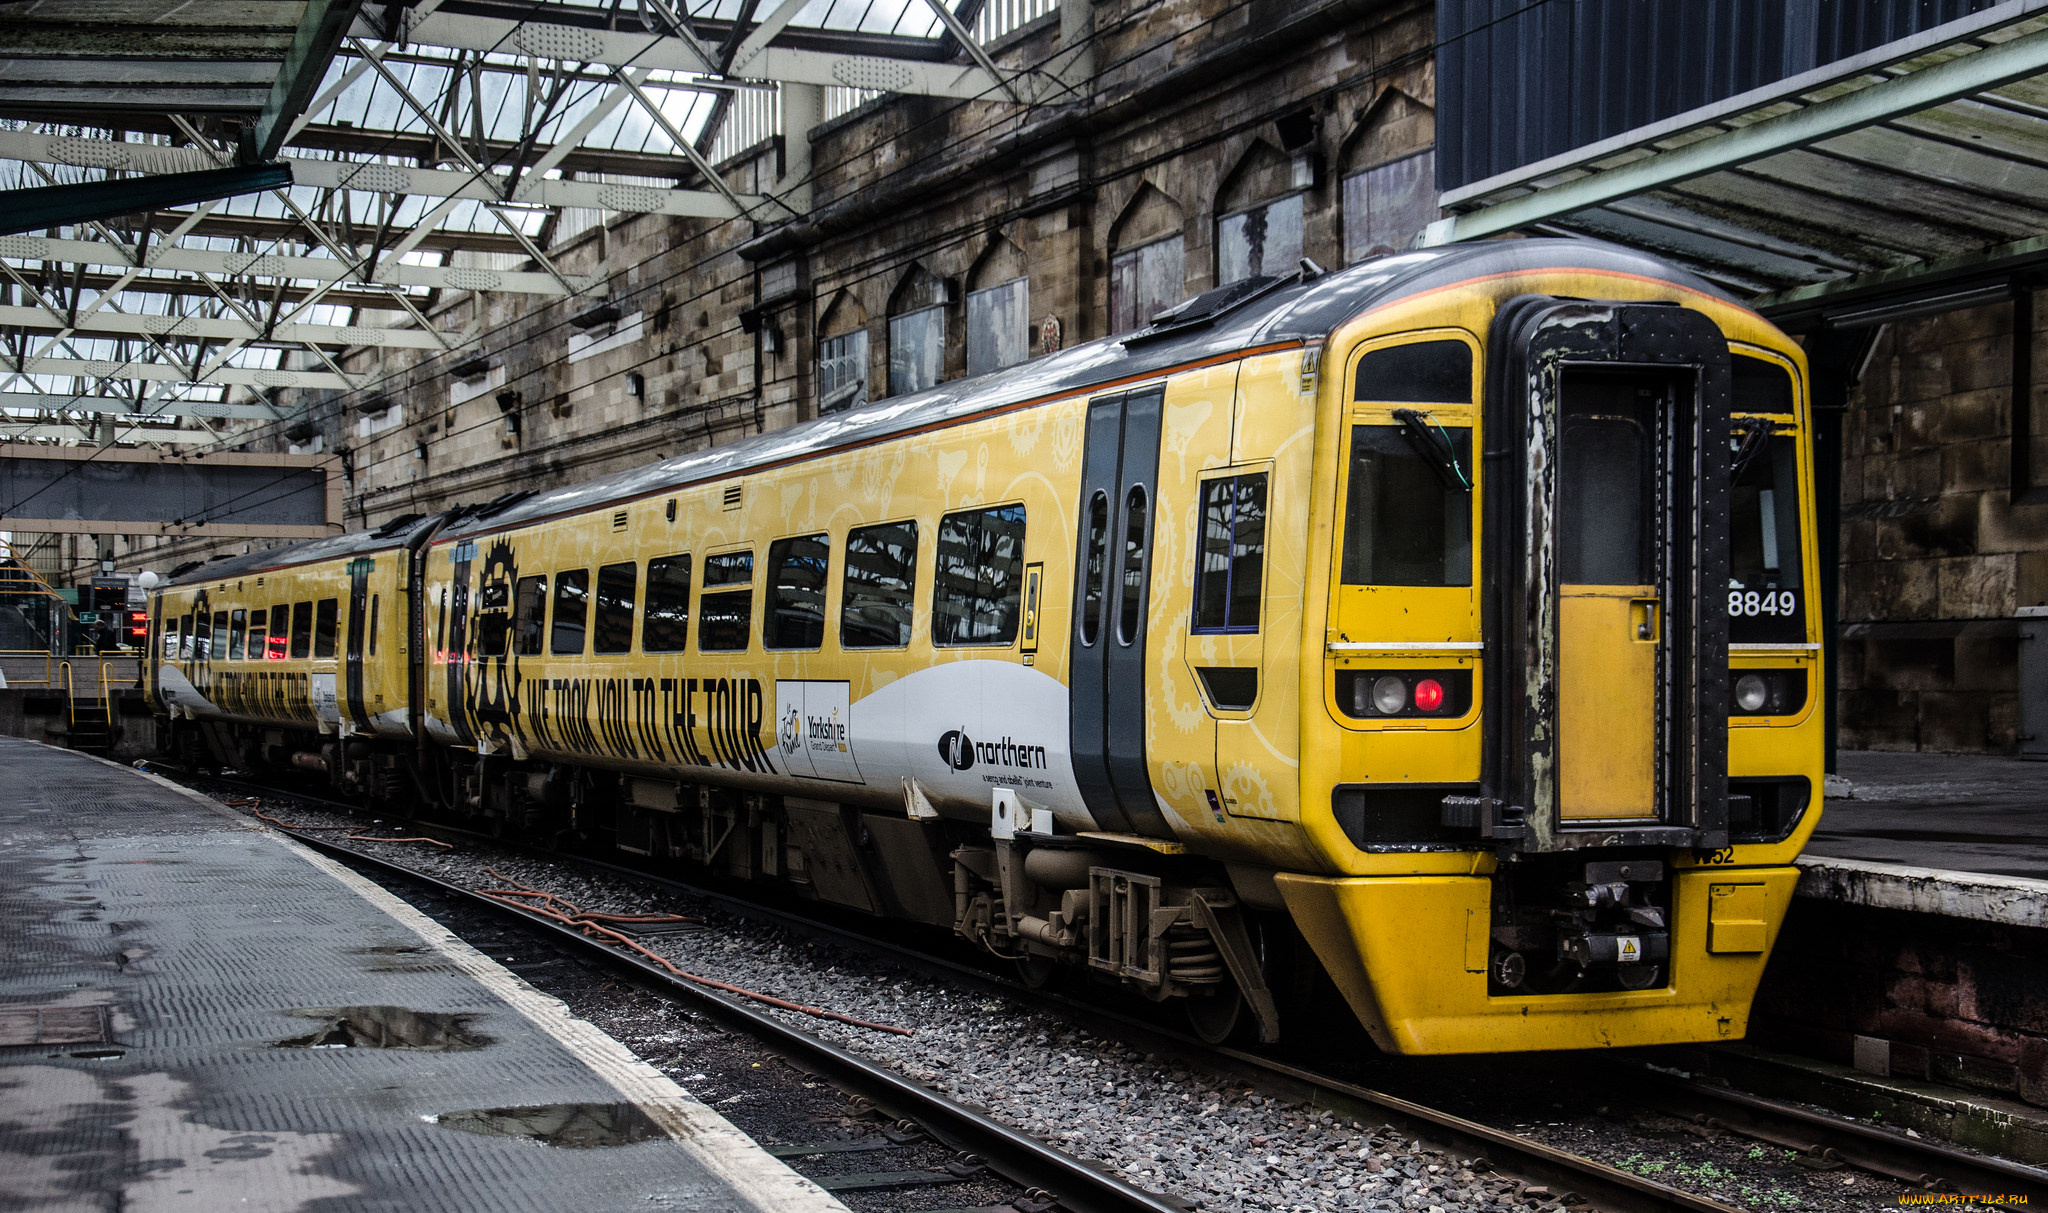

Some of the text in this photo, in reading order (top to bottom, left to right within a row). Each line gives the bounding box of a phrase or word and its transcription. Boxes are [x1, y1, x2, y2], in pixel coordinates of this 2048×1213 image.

[1728, 591, 1795, 616] 8849
[527, 678, 778, 775] WE TOOK YOU TO THE TOUR
[808, 708, 845, 741] Yorkshire
[975, 737, 1047, 769] northern
